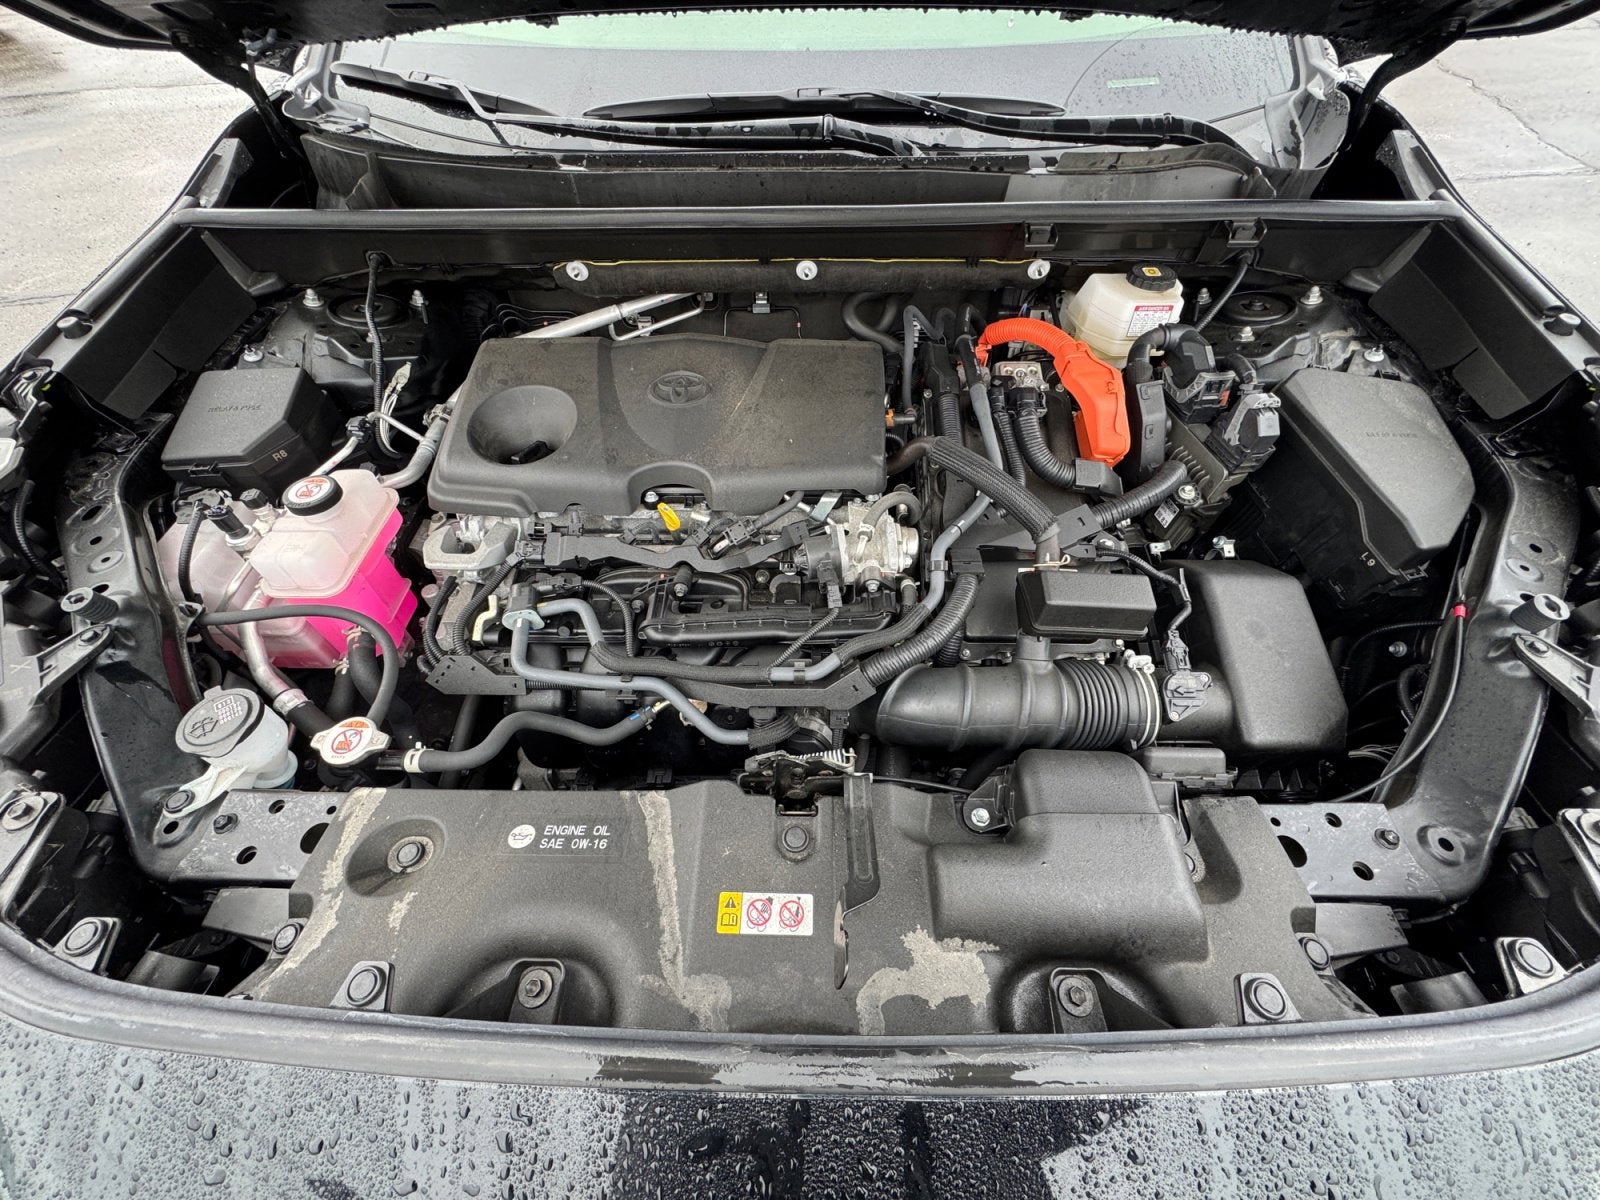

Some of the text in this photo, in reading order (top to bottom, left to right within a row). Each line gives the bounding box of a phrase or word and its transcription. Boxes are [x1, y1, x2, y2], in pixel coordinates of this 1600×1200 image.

[272, 449, 288, 462] R8
[543, 825, 611, 836] ENGINE OIL
[539, 838, 608, 849] SAE 0W-16
